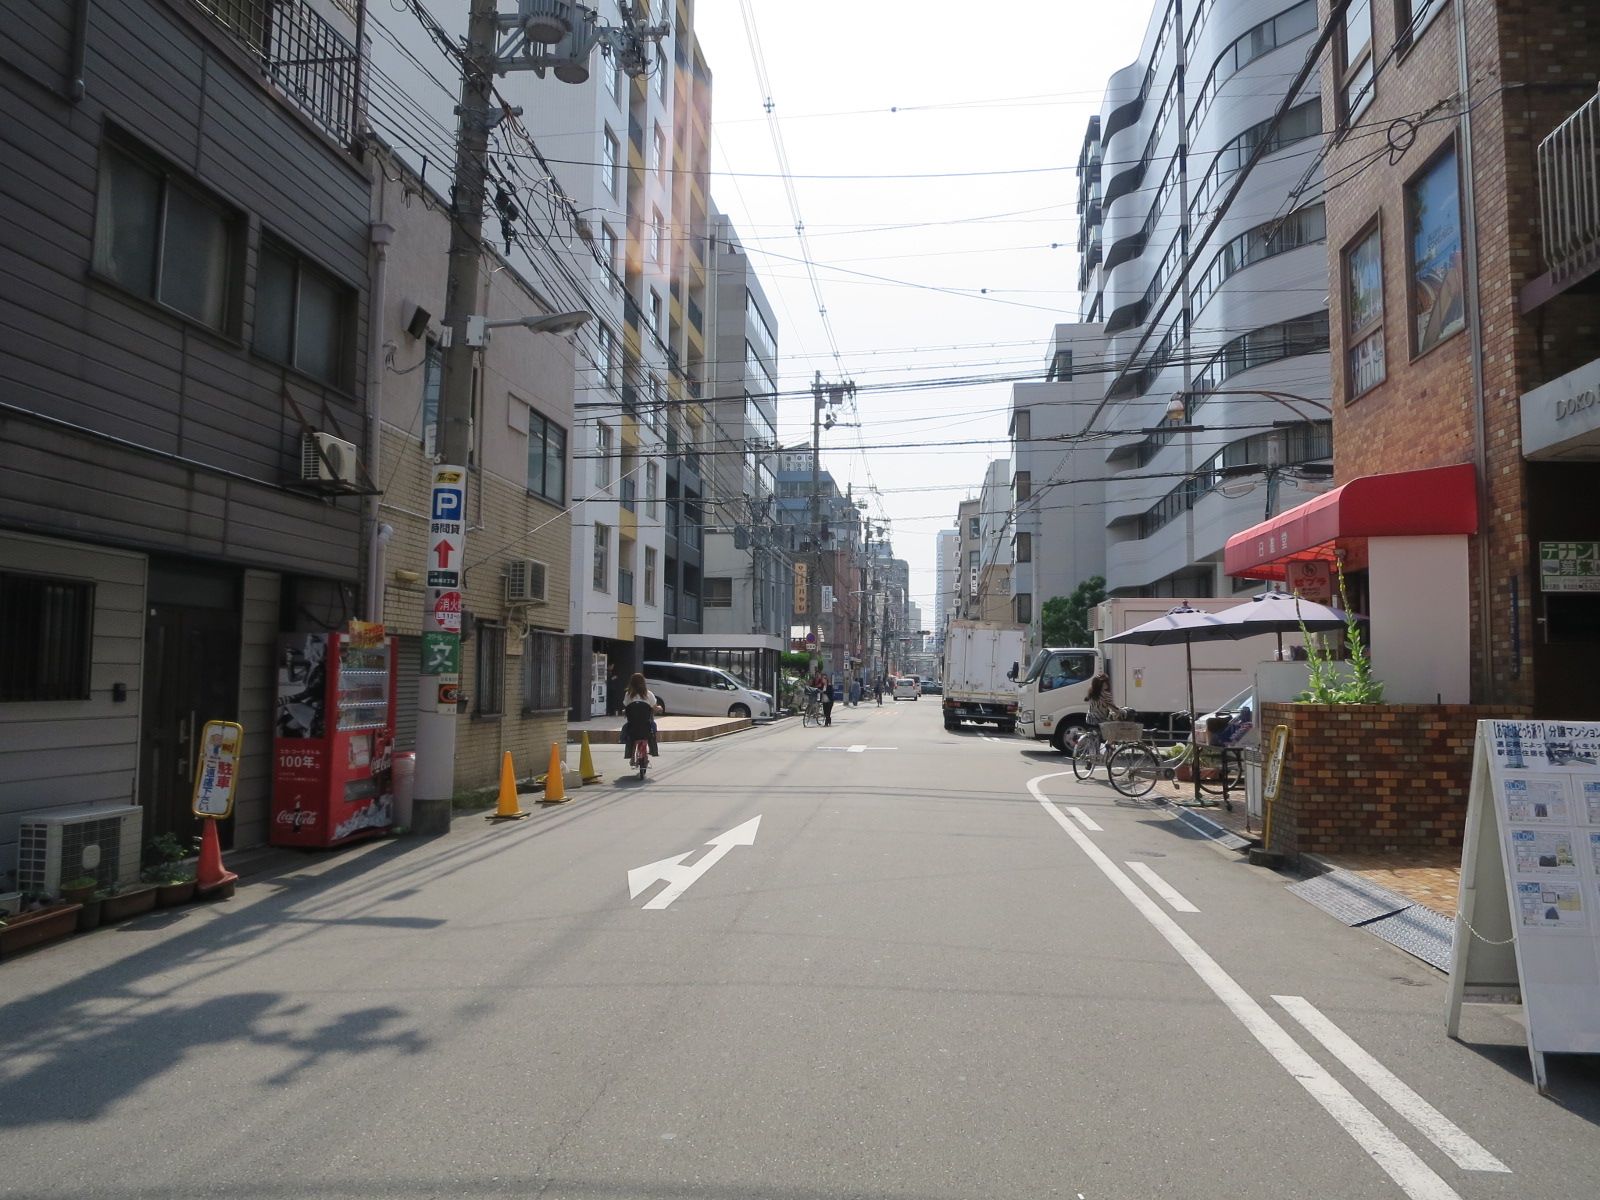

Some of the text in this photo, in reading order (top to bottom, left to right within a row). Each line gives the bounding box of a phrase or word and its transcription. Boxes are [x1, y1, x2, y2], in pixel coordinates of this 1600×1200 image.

[1555, 389, 1596, 421] DOKO
[436, 493, 458, 516] P
[431, 523, 460, 535] 時間貸
[1542, 544, 1600, 560] テナン
